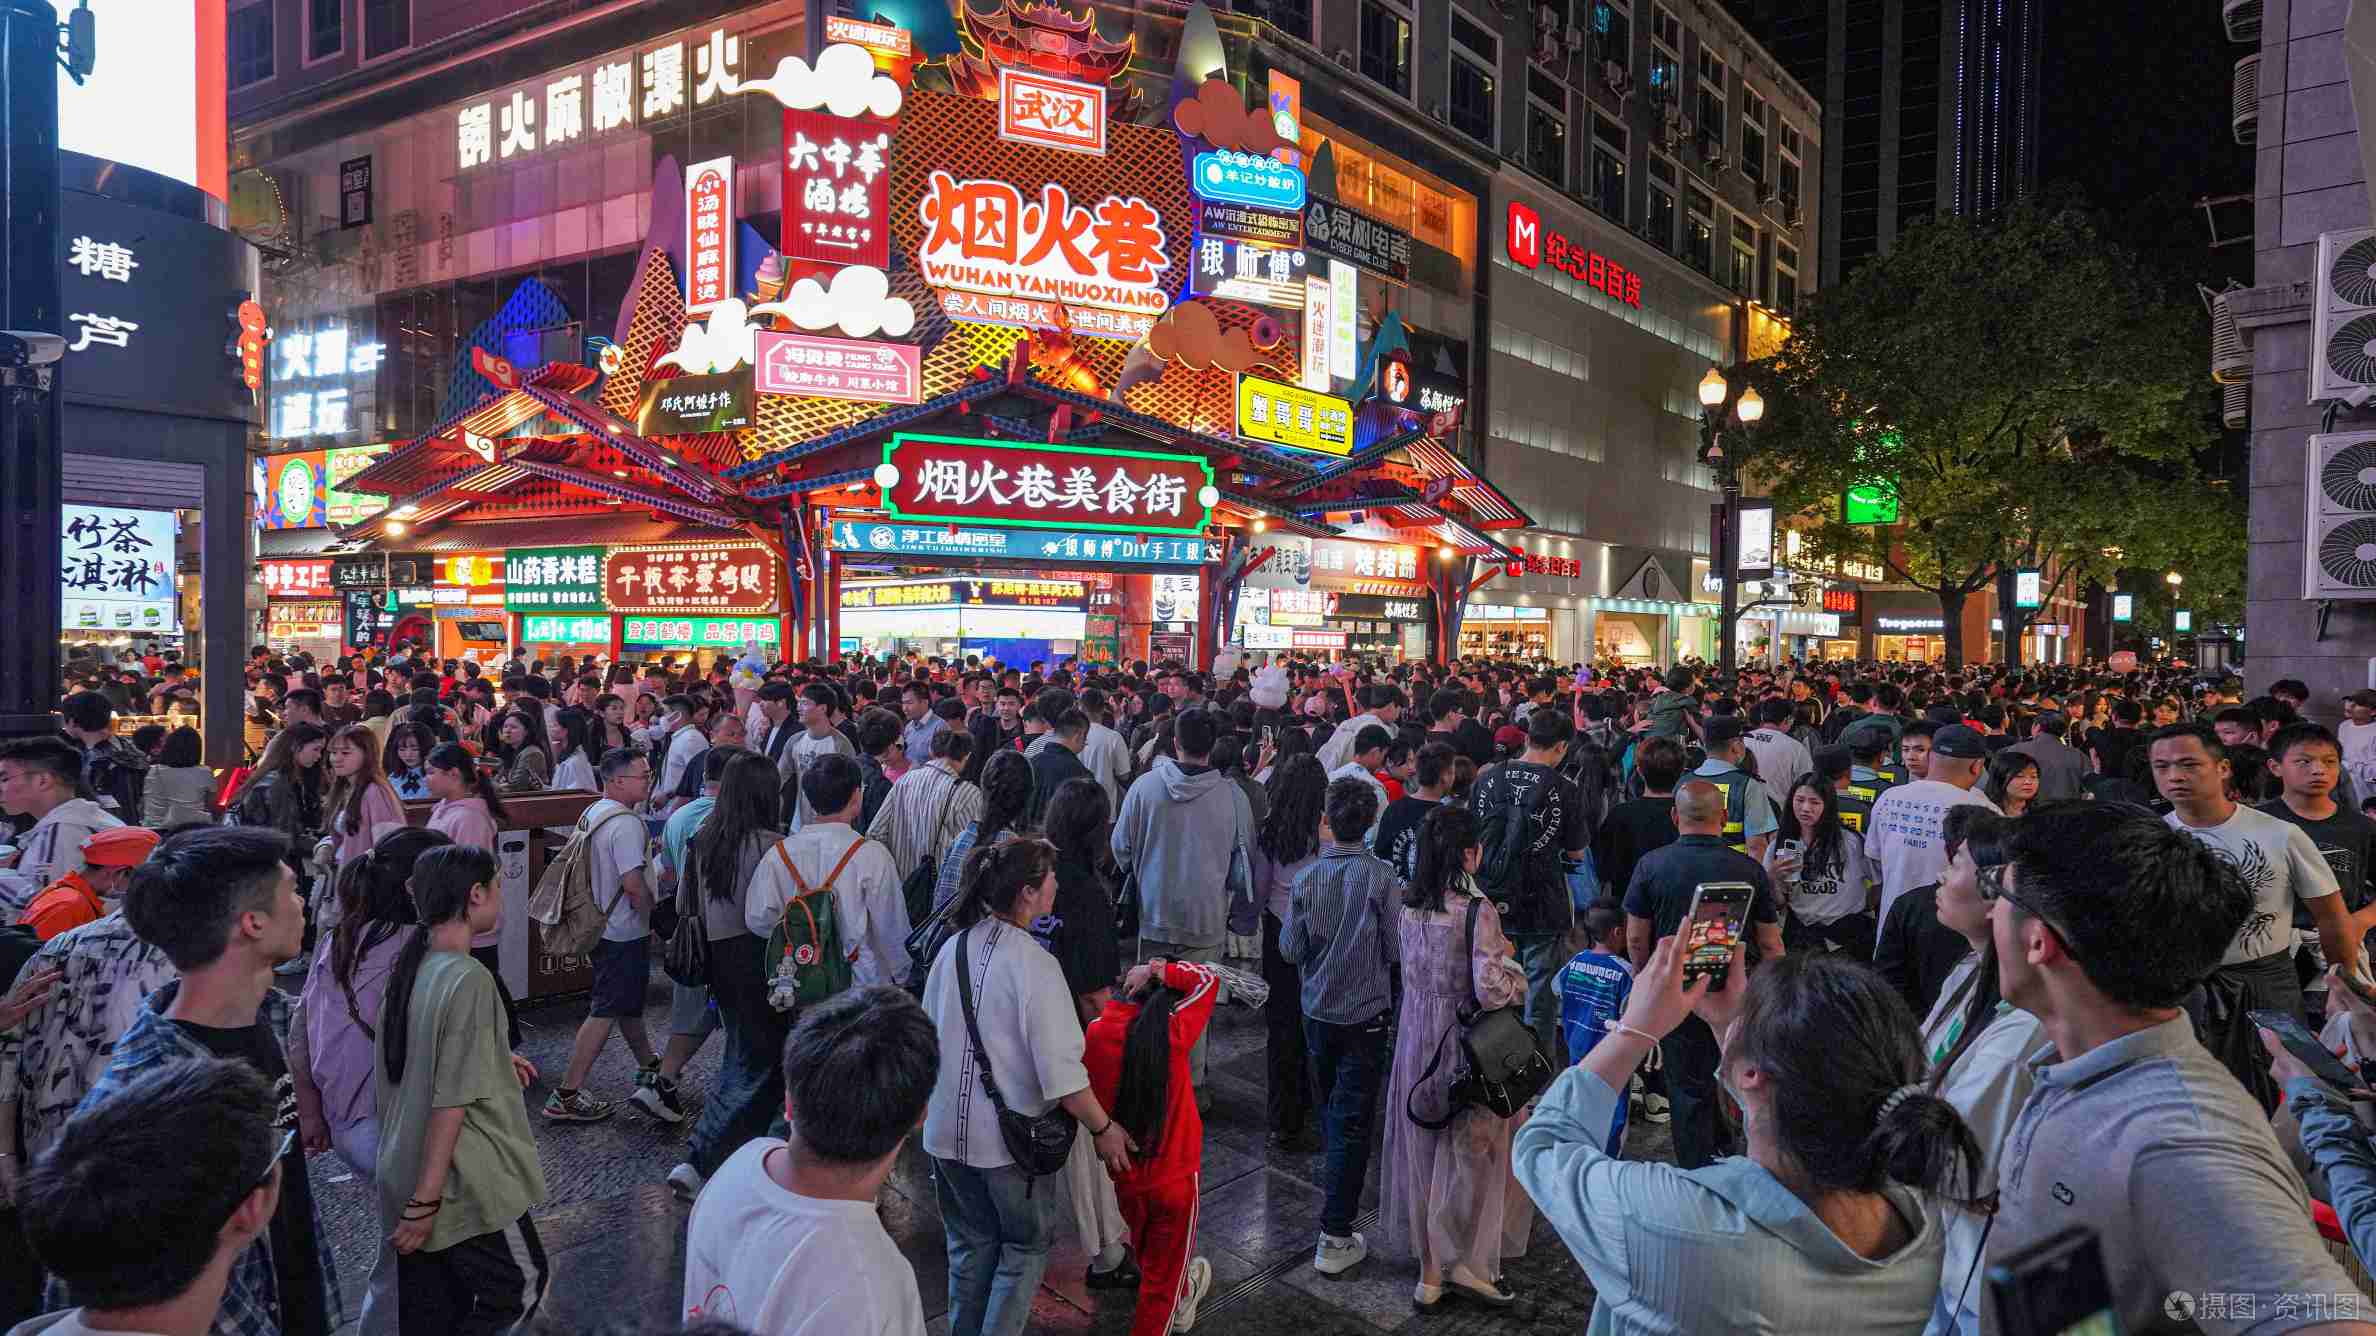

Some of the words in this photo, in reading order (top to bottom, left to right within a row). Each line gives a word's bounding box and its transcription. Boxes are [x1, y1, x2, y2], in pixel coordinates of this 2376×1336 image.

[1014, 90, 1090, 131] 武汉
[925, 174, 1168, 284] 烟火巷
[68, 235, 139, 282] 糖
[1543, 230, 1643, 309] 纪念日百货
[926, 261, 1012, 289] WUHAN
[1016, 274, 1165, 309] YANHUOXIANG
[942, 293, 1049, 324] 尝人间烟火
[68, 312, 139, 352] 芦
[912, 457, 1188, 518] 烟火巷美食街
[264, 563, 330, 589] 串串工厂
[506, 555, 598, 585] 山药香米糕
[1903, 838, 1928, 849] PARIS
